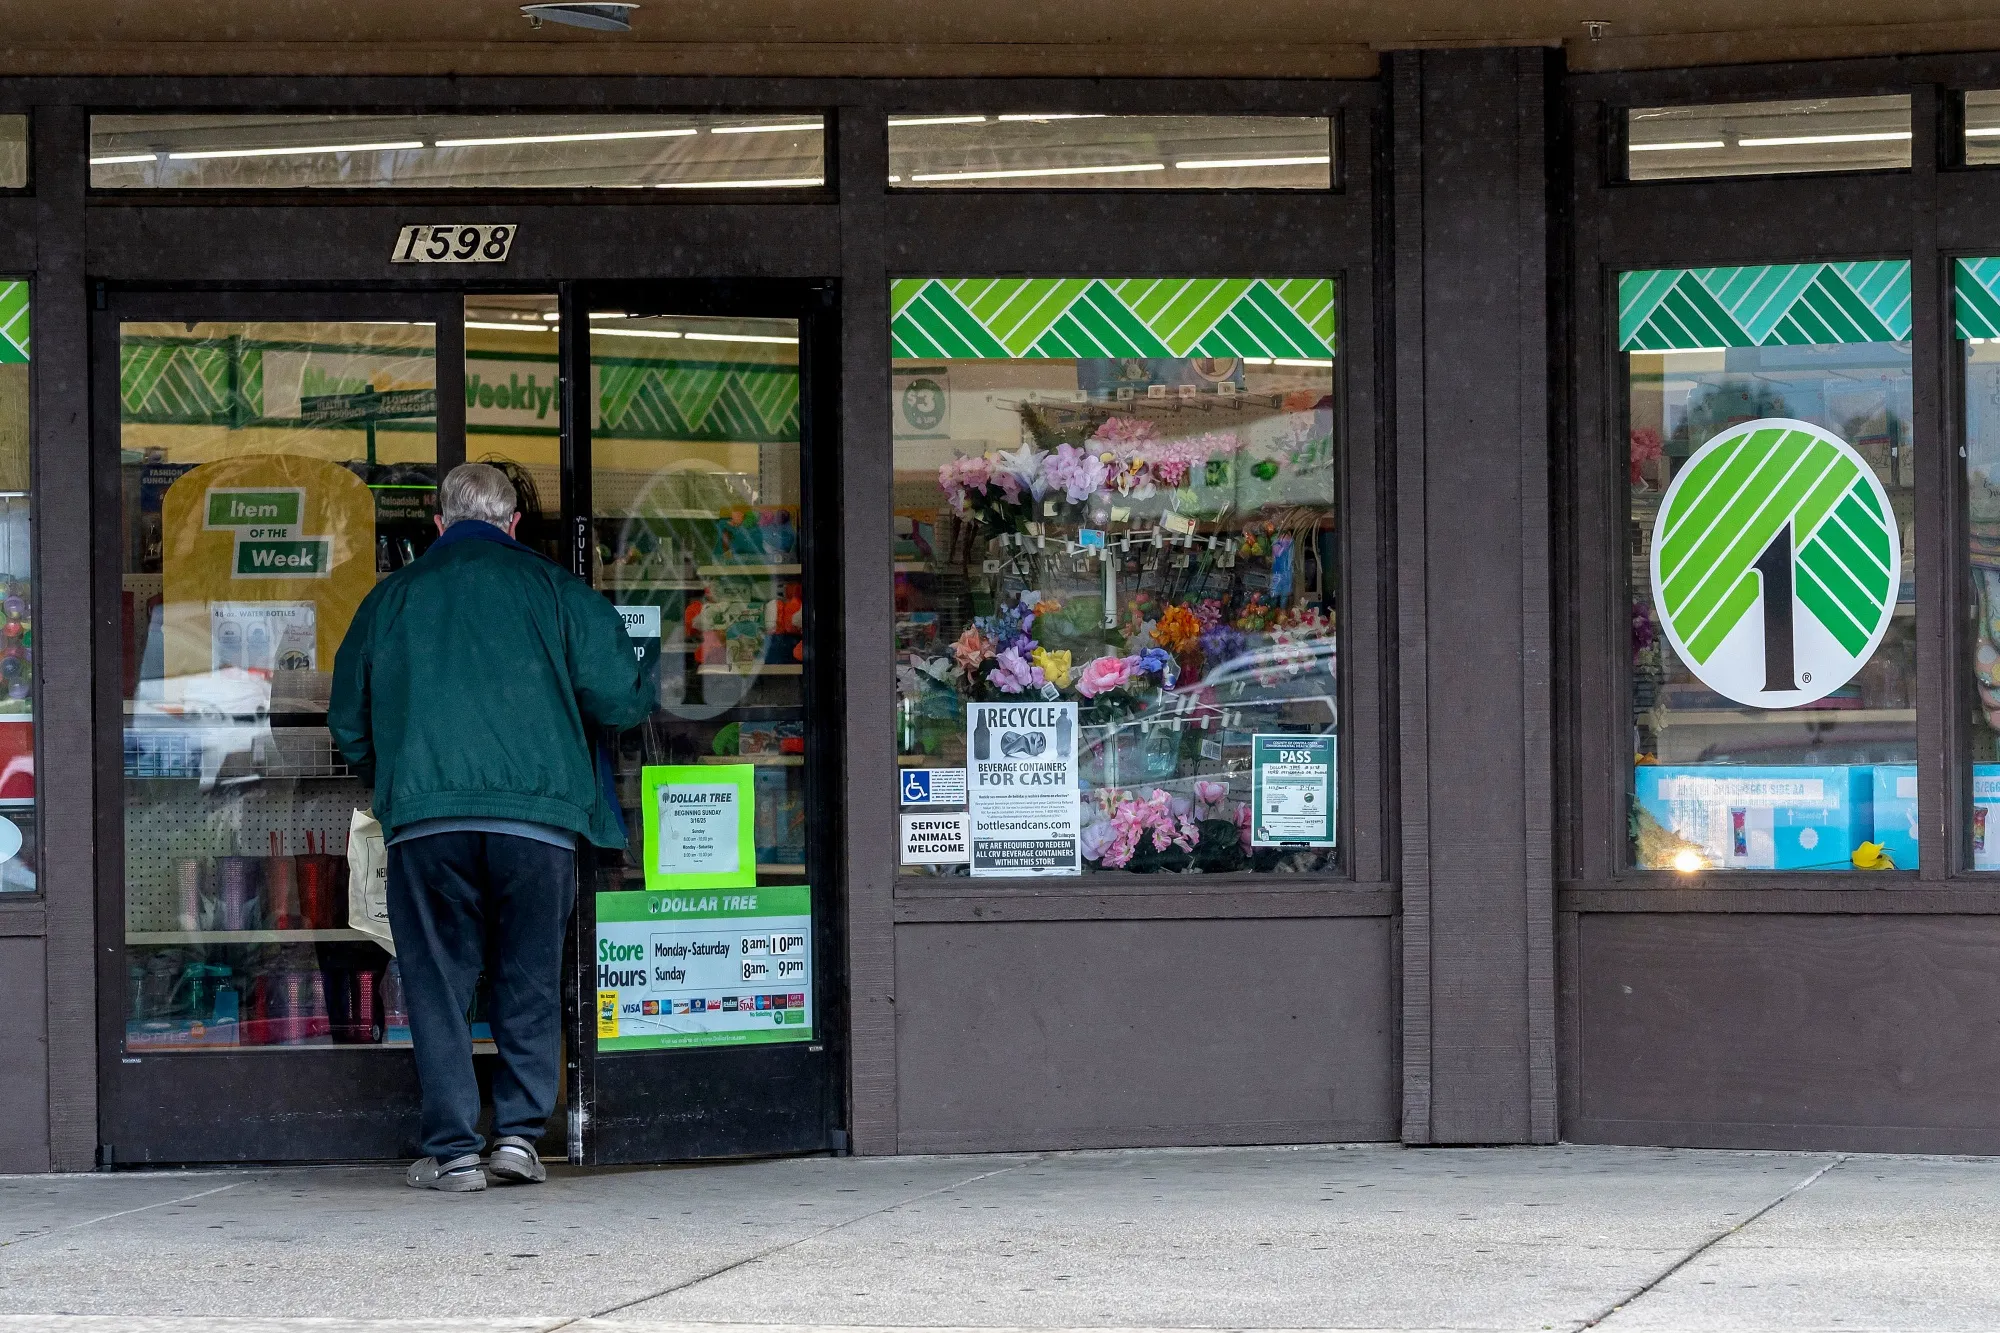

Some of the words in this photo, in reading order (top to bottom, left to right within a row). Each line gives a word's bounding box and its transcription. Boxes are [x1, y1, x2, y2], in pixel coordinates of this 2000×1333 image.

[403, 227, 510, 260] 1598
[381, 496, 420, 506] Reloadable
[230, 500, 278, 517] Item
[377, 508, 404, 518] Prepaid
[406, 509, 425, 518] Cards
[250, 529, 264, 537] OF
[267, 529, 287, 538] THE
[252, 548, 313, 567] Week
[621, 613, 645, 625] azon
[987, 707, 1056, 728] RECYCLE
[1280, 750, 1312, 763] PASS
[978, 763, 1018, 772] BEVERAGE
[1019, 762, 1067, 772] CONTAINERS
[979, 772, 1014, 786] FOR
[1019, 772, 1066, 786] CASH
[670, 793, 707, 803] DOLLAR
[710, 793, 732, 803] TREE
[911, 821, 960, 830] SERVICE
[977, 820, 1071, 830] bottlesandcans.com
[910, 832, 962, 842] ANIMALS
[907, 844, 965, 853] WELCOME
[979, 842, 990, 850] WE
[1003, 841, 1035, 849] REQUIRED
[976, 850, 987, 858] ALL
[1002, 849, 1033, 857] BEVERAGE
[1034, 849, 1074, 857] CONTAINERS
[995, 858, 1019, 866] WITHIN
[1035, 857, 1055, 865] STORE
[661, 897, 718, 913] DOLLAR
[723, 895, 758, 911] TREE
[599, 938, 644, 962] Store
[655, 940, 730, 960] Monday-Saturday
[598, 964, 647, 988] Hours
[655, 966, 686, 983] Sunday
[622, 1003, 641, 1013] VISA
[740, 1002, 755, 1011] STAR
